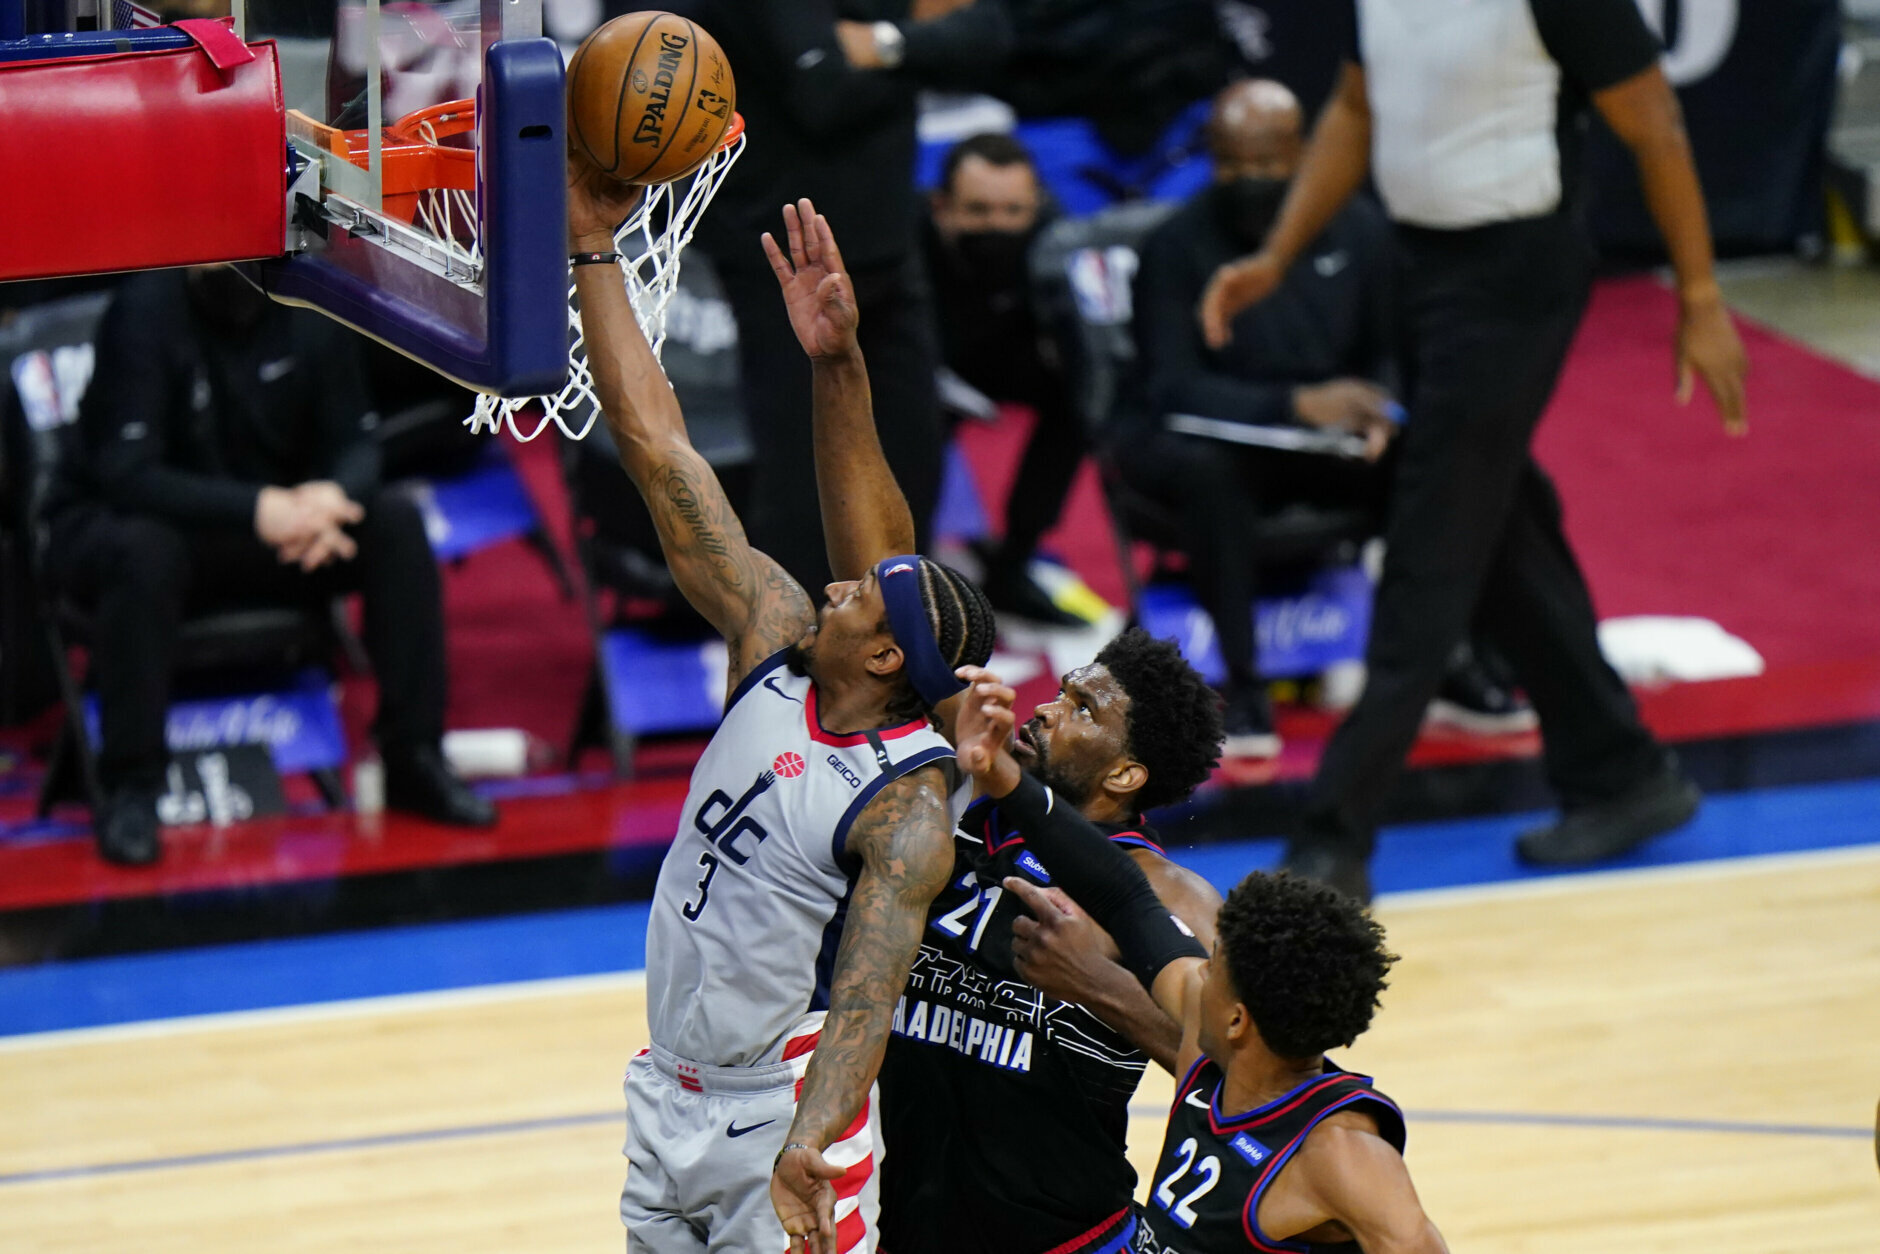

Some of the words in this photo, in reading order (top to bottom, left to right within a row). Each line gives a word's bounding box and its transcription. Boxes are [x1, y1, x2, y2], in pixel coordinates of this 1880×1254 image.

[633, 33, 689, 148] SPALDING
[826, 754, 862, 788] GEICO
[683, 852, 718, 922] 3
[931, 871, 1003, 953] 21
[1153, 1137, 1221, 1229] 22
